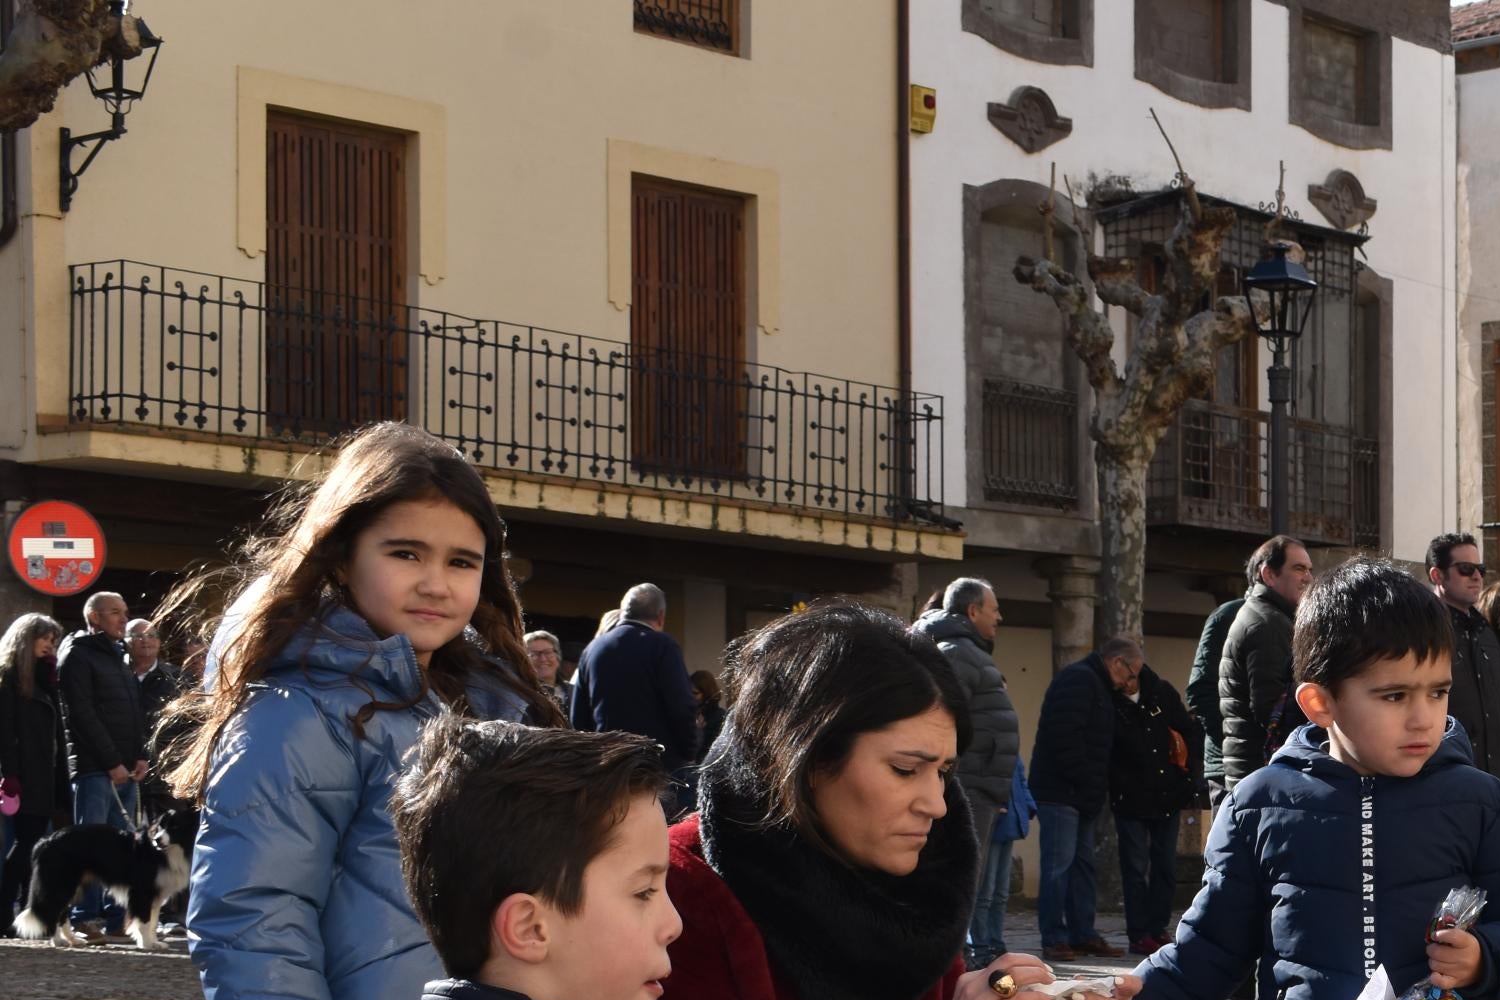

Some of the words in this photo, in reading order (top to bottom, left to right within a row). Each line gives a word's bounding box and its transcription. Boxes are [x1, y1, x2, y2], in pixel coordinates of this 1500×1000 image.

[1361, 823, 1374, 867] MAKE
[1362, 872, 1374, 902] ART
[1363, 916, 1375, 933] BE
[1364, 938, 1376, 979] BOLD
